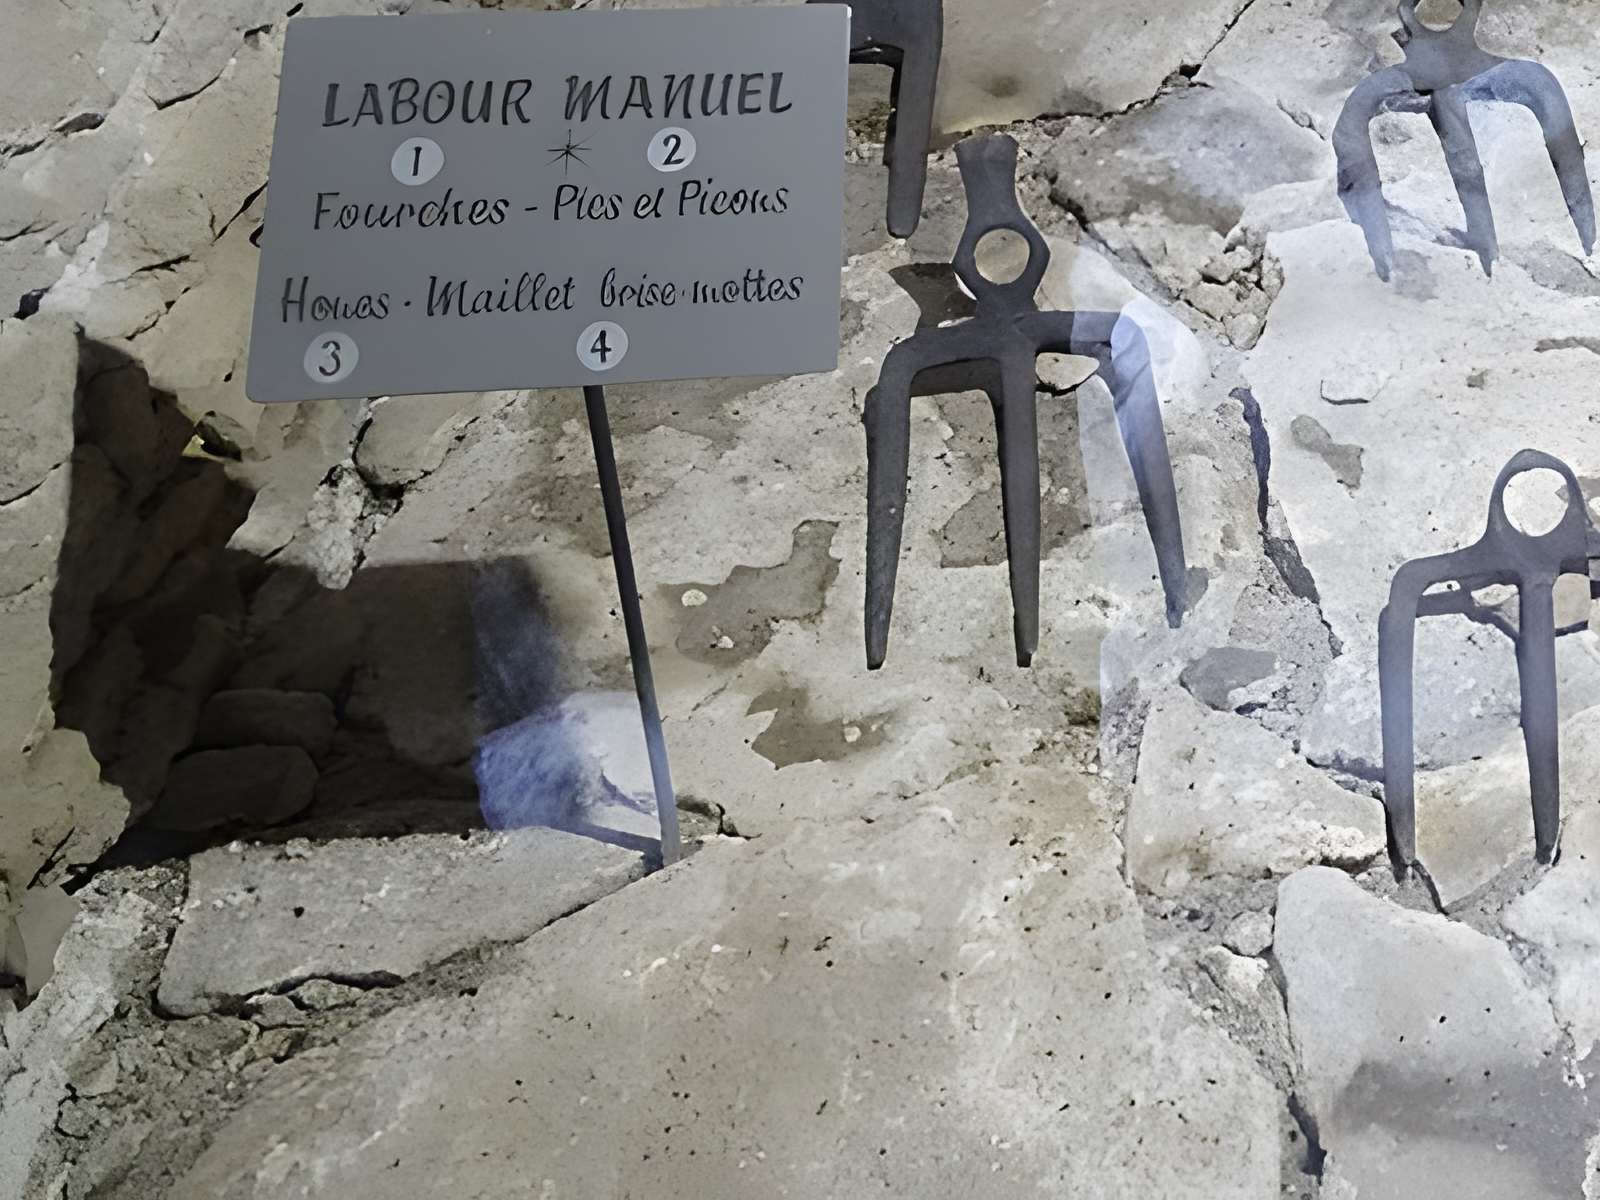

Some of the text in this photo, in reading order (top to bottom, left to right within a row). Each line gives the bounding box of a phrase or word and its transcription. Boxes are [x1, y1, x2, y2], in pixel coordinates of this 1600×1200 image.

[321, 71, 793, 128] LABOUR MANUEL
[411, 145, 423, 177] 1
[661, 133, 685, 166] 2
[313, 187, 510, 231] Fourches
[632, 187, 665, 220] et
[426, 271, 576, 318] Maillet
[318, 339, 341, 377] 3
[590, 329, 612, 364] 4
